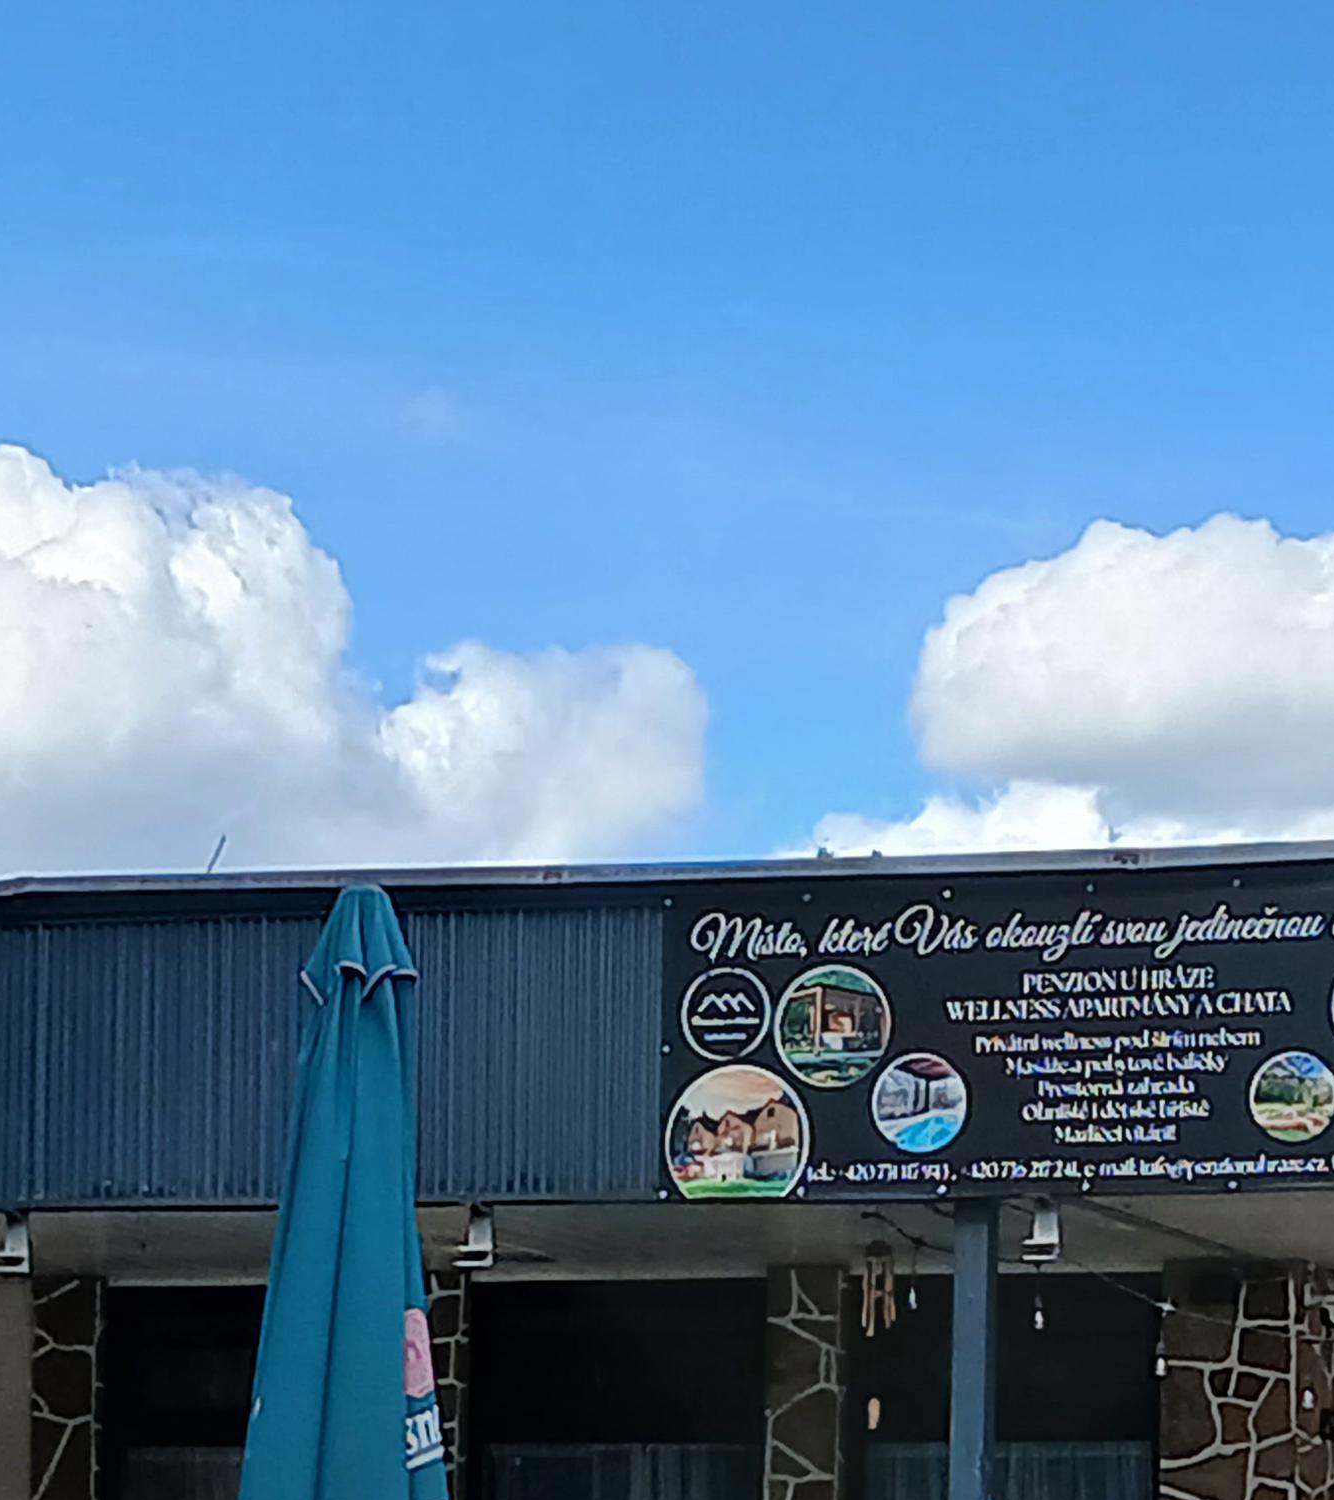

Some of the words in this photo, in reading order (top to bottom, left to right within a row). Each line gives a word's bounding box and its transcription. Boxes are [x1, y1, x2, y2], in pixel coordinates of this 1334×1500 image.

[895, 904, 977, 955] Vás
[986, 909, 1103, 962] okouzlí
[1100, 919, 1168, 945] svou
[1153, 904, 1325, 959] jedinečnou
[1023, 967, 1117, 994] PENZION
[1120, 966, 1138, 990] U
[1141, 963, 1215, 990] HRÁZE
[946, 998, 1062, 1021] WELLNESS
[1064, 992, 1194, 1020] APARTMÁNY
[1195, 994, 1213, 1018] A
[1217, 991, 1292, 1016] CHATA
[1114, 1029, 1149, 1054] pod
[1199, 1026, 1261, 1047] nebem
